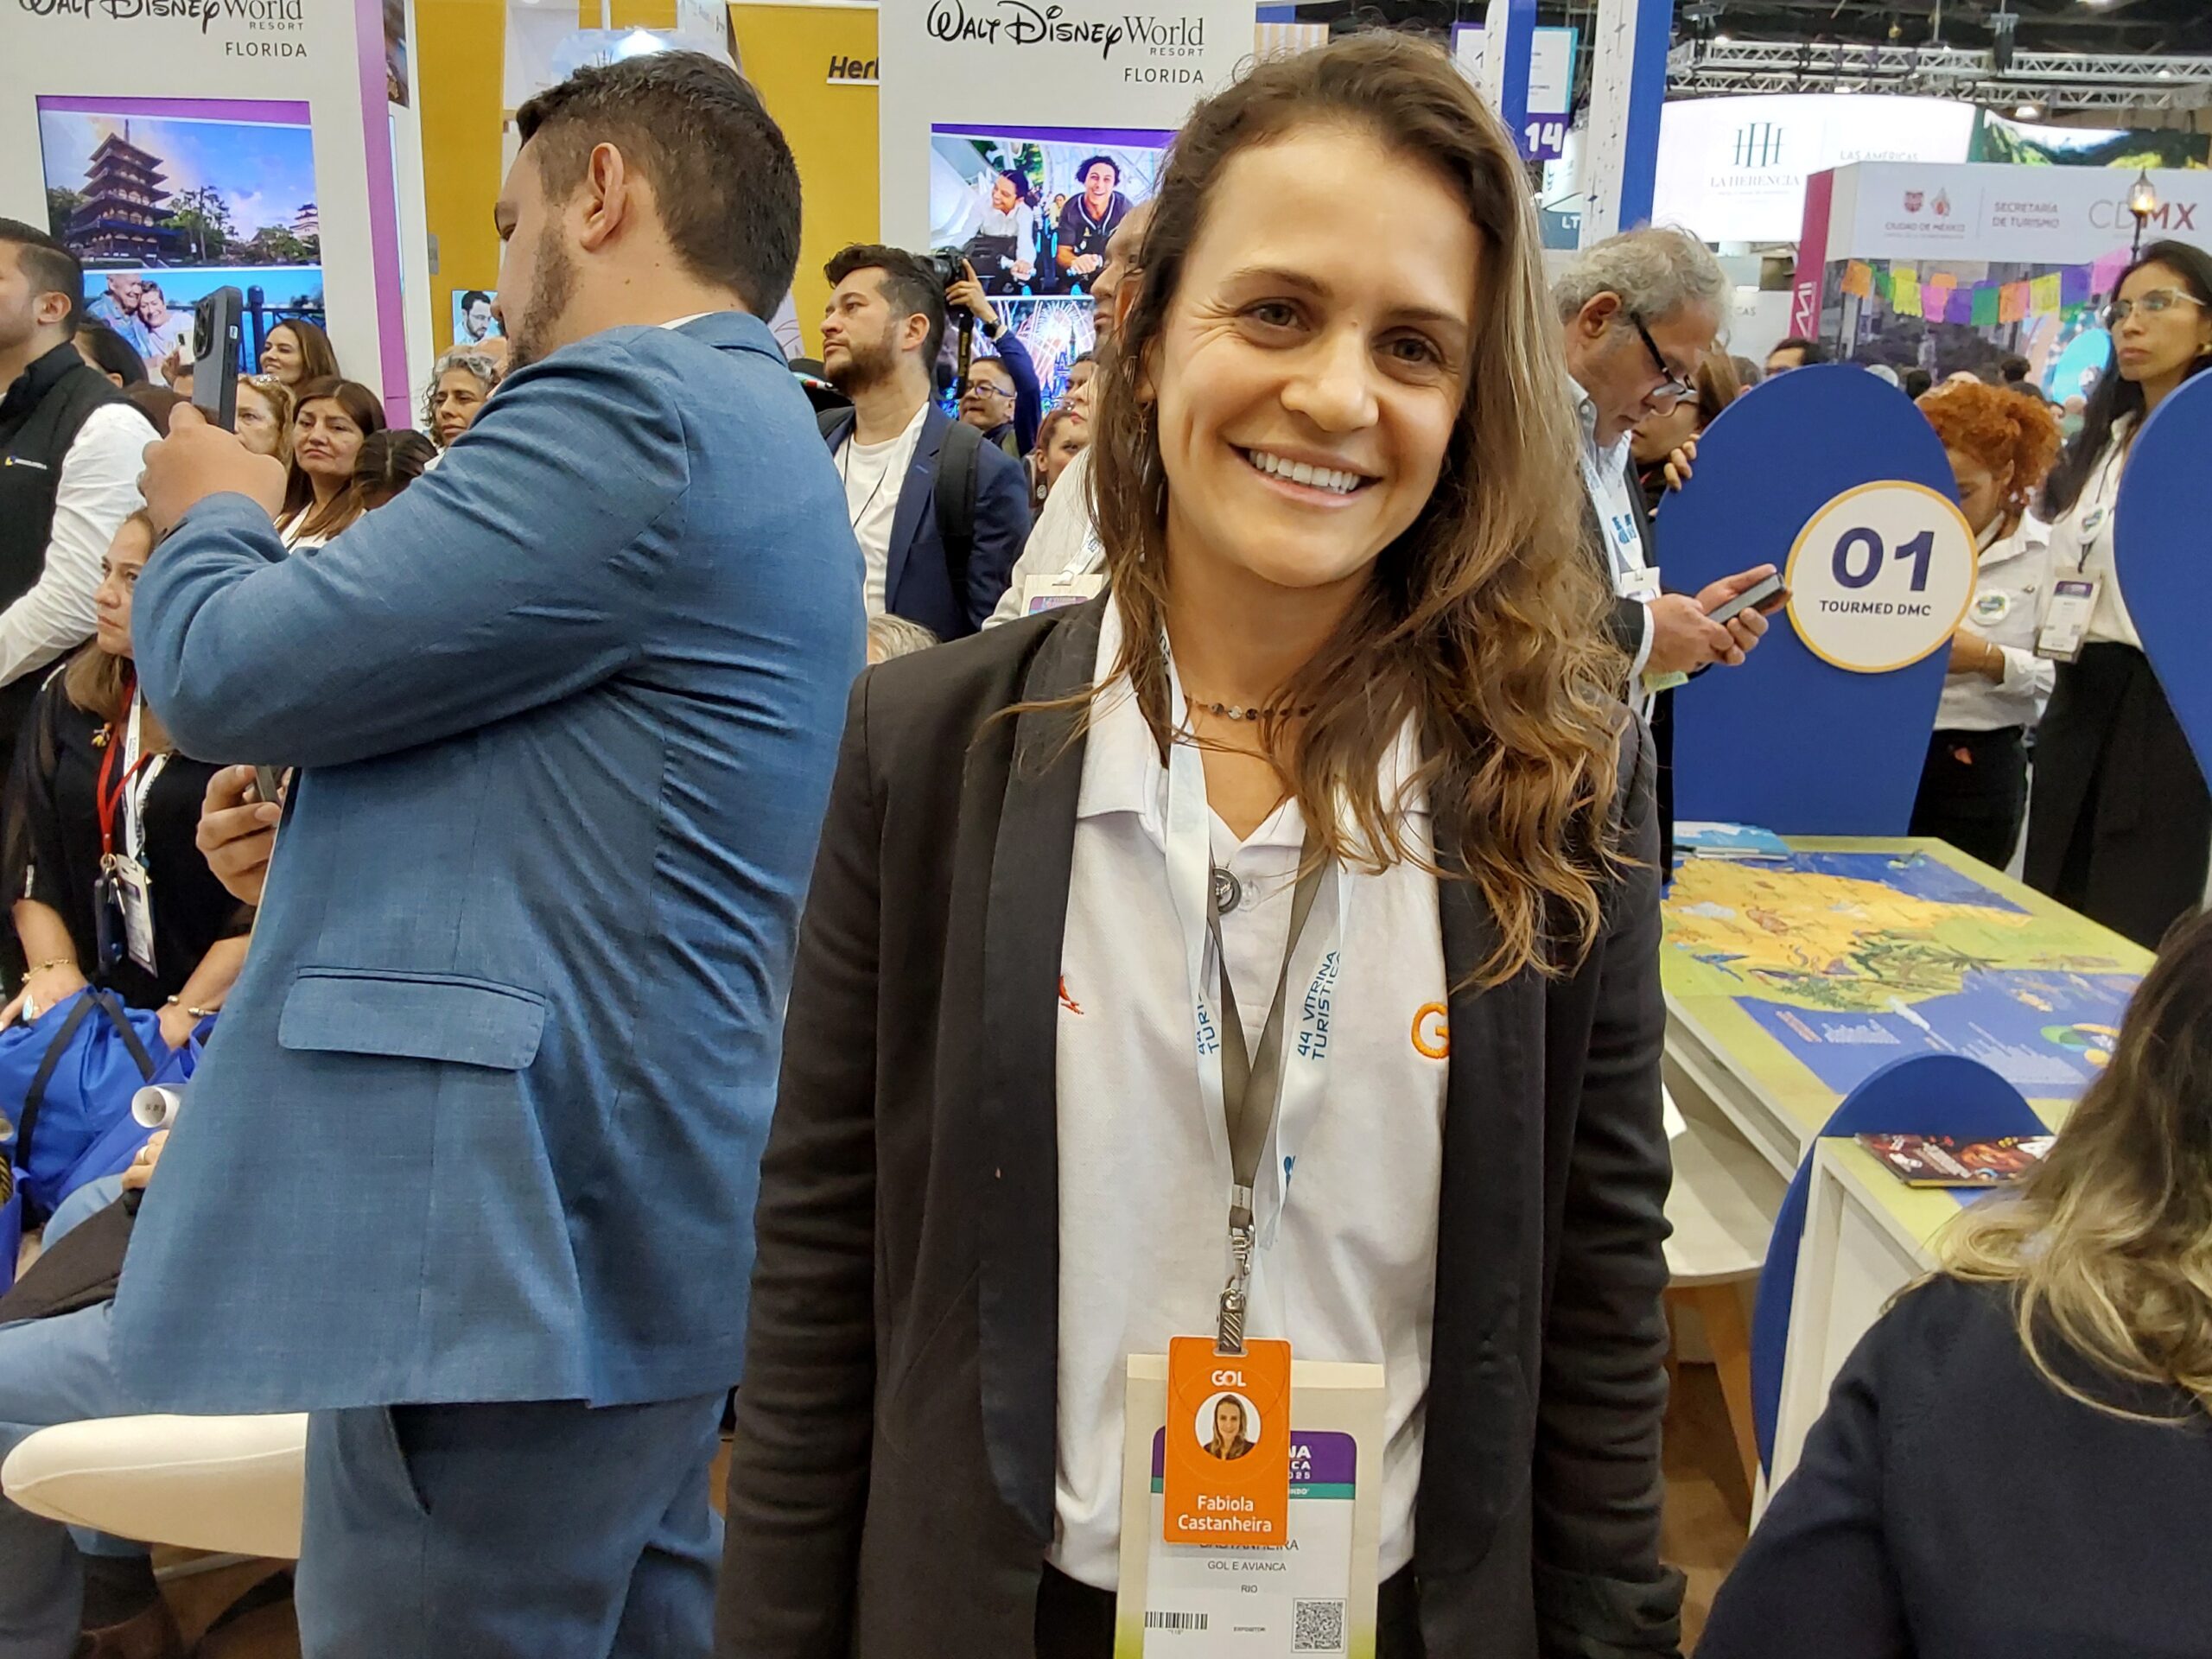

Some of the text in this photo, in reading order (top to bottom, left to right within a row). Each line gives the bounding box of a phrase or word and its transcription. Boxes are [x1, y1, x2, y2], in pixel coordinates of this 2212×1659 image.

[226, 0, 303, 20] World
[250, 22, 303, 31] RESORT
[1123, 16, 1205, 46] World
[226, 42, 307, 57] FLORIDA
[1150, 47, 1205, 57] RESORT
[1124, 67, 1205, 85] FLORIDA
[1524, 122, 1563, 152] 14
[1710, 175, 1800, 188] LA HERENCIA
[1992, 216, 2061, 229] DE TURISMO
[2088, 199, 2197, 231] CDMX
[1832, 527, 1935, 591] 01
[1820, 600, 1932, 617] TOURMED DMC
[1297, 950, 1337, 1056] 44 VITRINA
[1198, 993, 1219, 1054] TURI
[1211, 1370, 1247, 1387] GOL
[1198, 1495, 1254, 1512] Fabiola
[1178, 1514, 1272, 1533] Castanheira
[1207, 1560, 1287, 1572] GOL E AVIANCA
[1241, 1584, 1258, 1594] RIO
